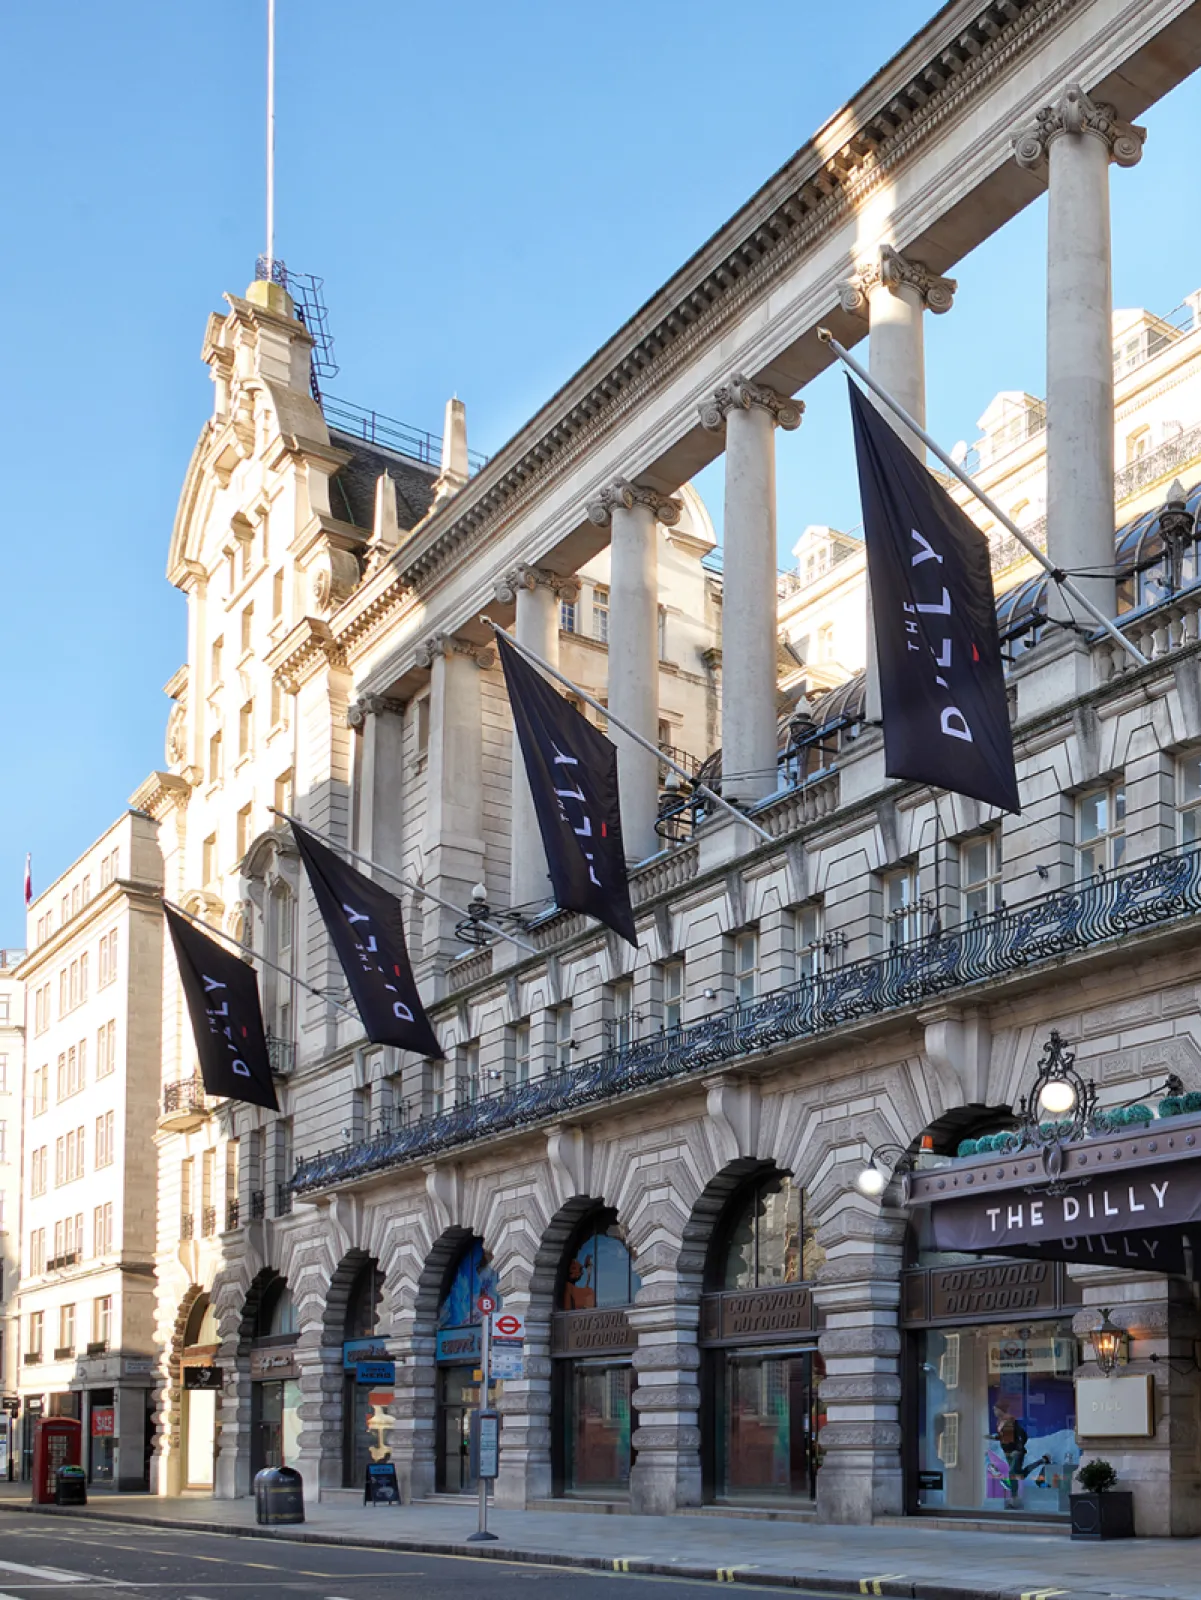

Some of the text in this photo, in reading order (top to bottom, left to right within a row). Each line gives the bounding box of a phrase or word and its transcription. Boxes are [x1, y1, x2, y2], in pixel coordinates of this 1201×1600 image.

[903, 601, 920, 651] THE
[343, 903, 415, 1023] DILY
[986, 1181, 1170, 1233] THE DILLY
[940, 1263, 1048, 1292] COTSWOLD
[482, 1299, 492, 1310] B
[729, 1291, 807, 1315] COTSWOLD
[946, 1287, 1040, 1313] OUTDOOR
[733, 1312, 800, 1333] OUTDOOR
[1092, 1401, 1123, 1412] DILL
